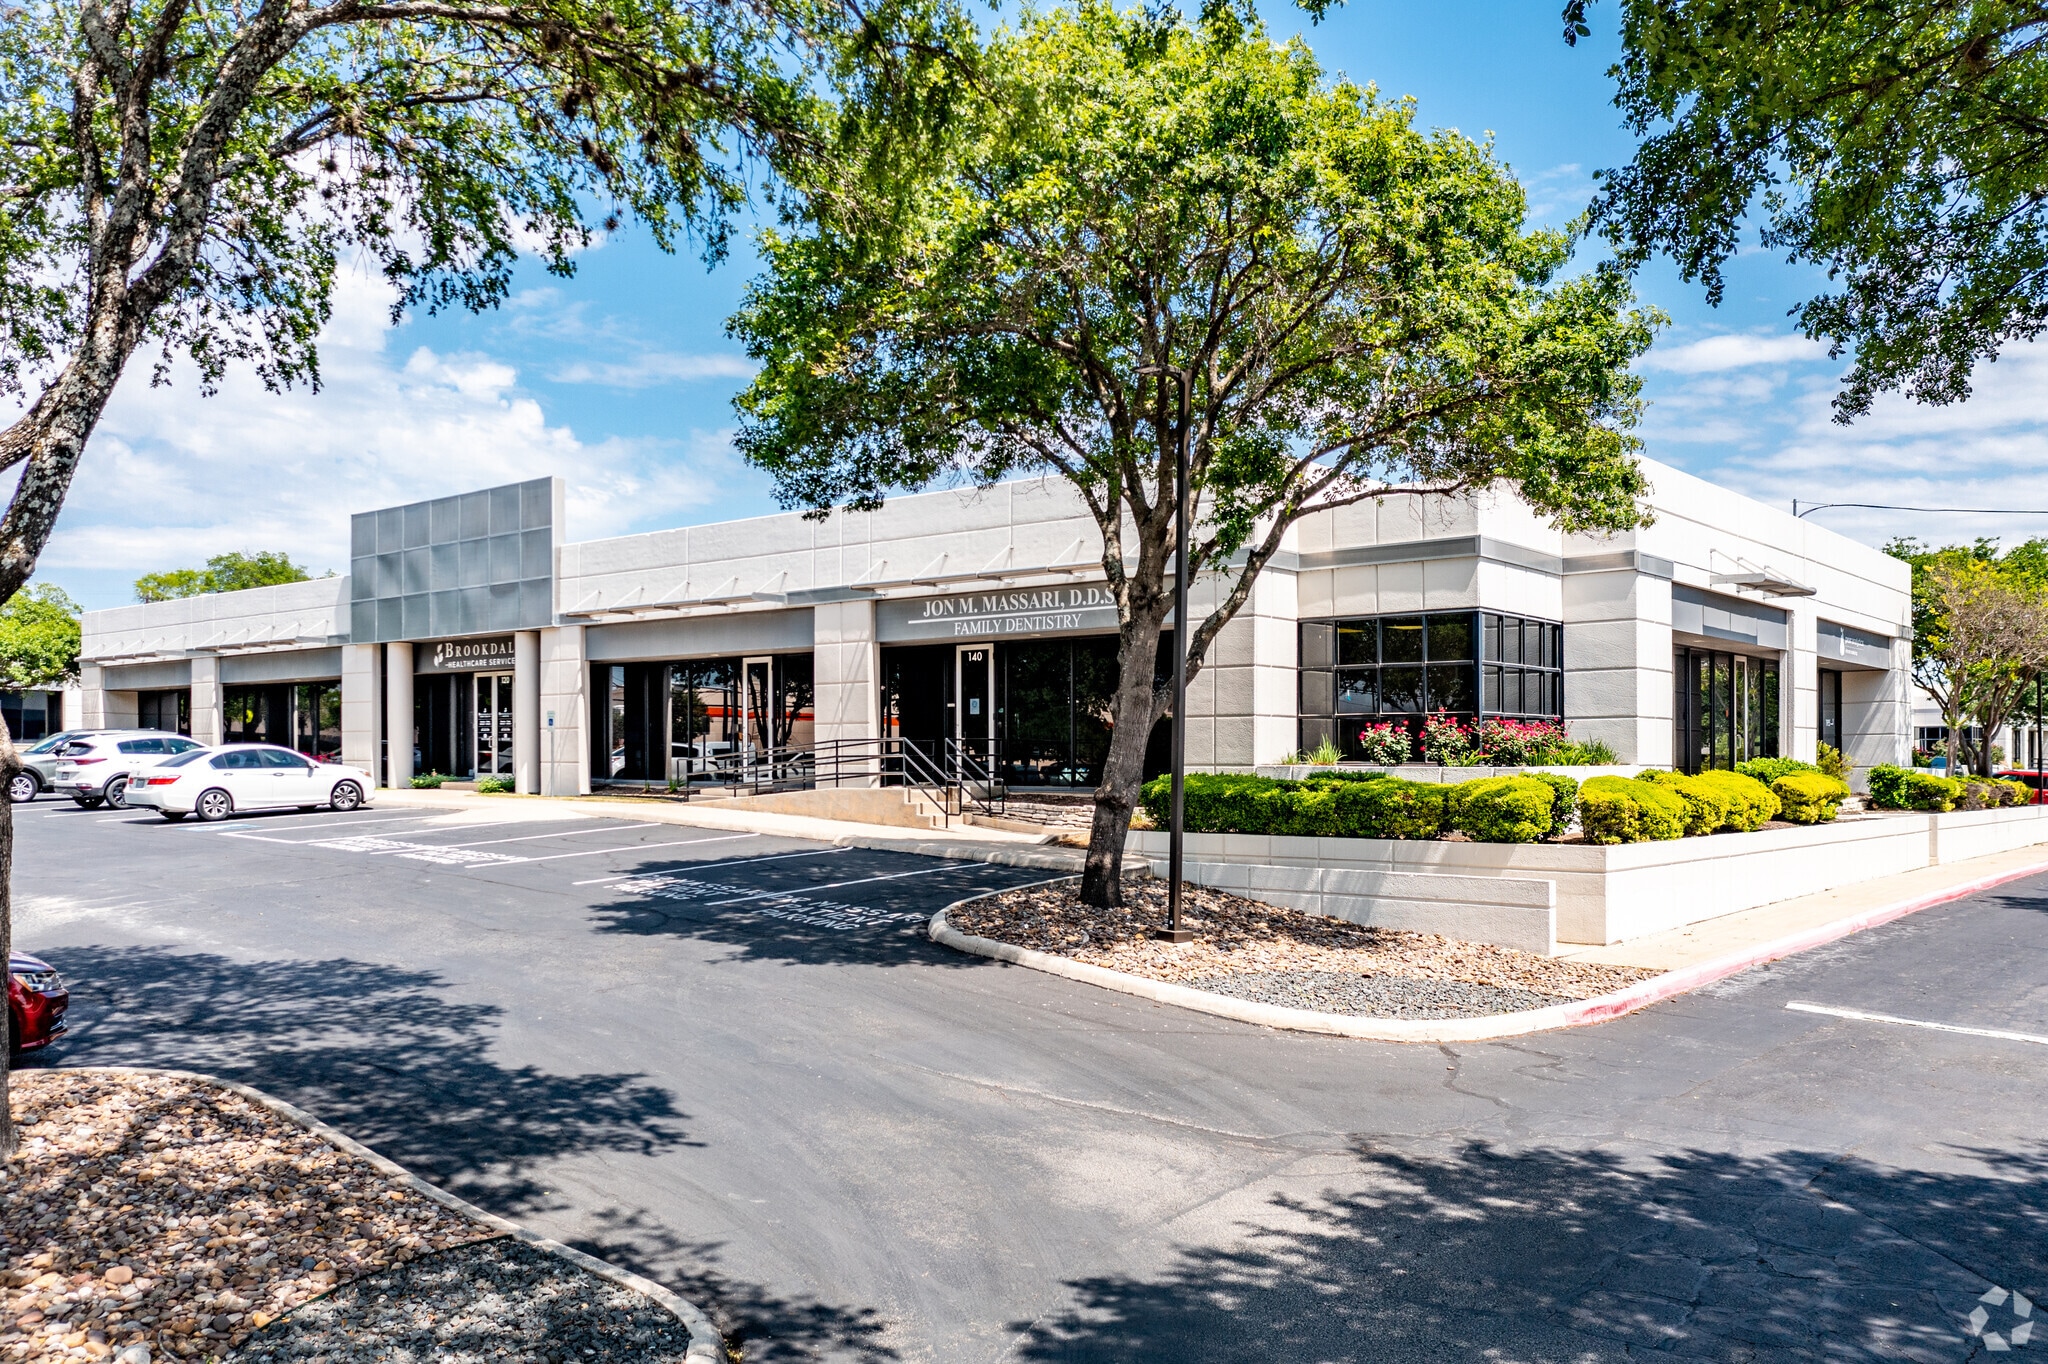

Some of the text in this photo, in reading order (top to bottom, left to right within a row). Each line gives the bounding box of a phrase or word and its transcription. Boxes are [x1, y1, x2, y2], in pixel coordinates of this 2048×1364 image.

[923, 599, 954, 617] JON
[959, 598, 978, 614] M.
[982, 590, 1065, 610] MASSARI,
[954, 613, 1082, 636] FAMILY DENTISTRY
[445, 642, 514, 658] BROOKDAL
[967, 651, 982, 662] 140
[488, 657, 515, 666] SERVICE
